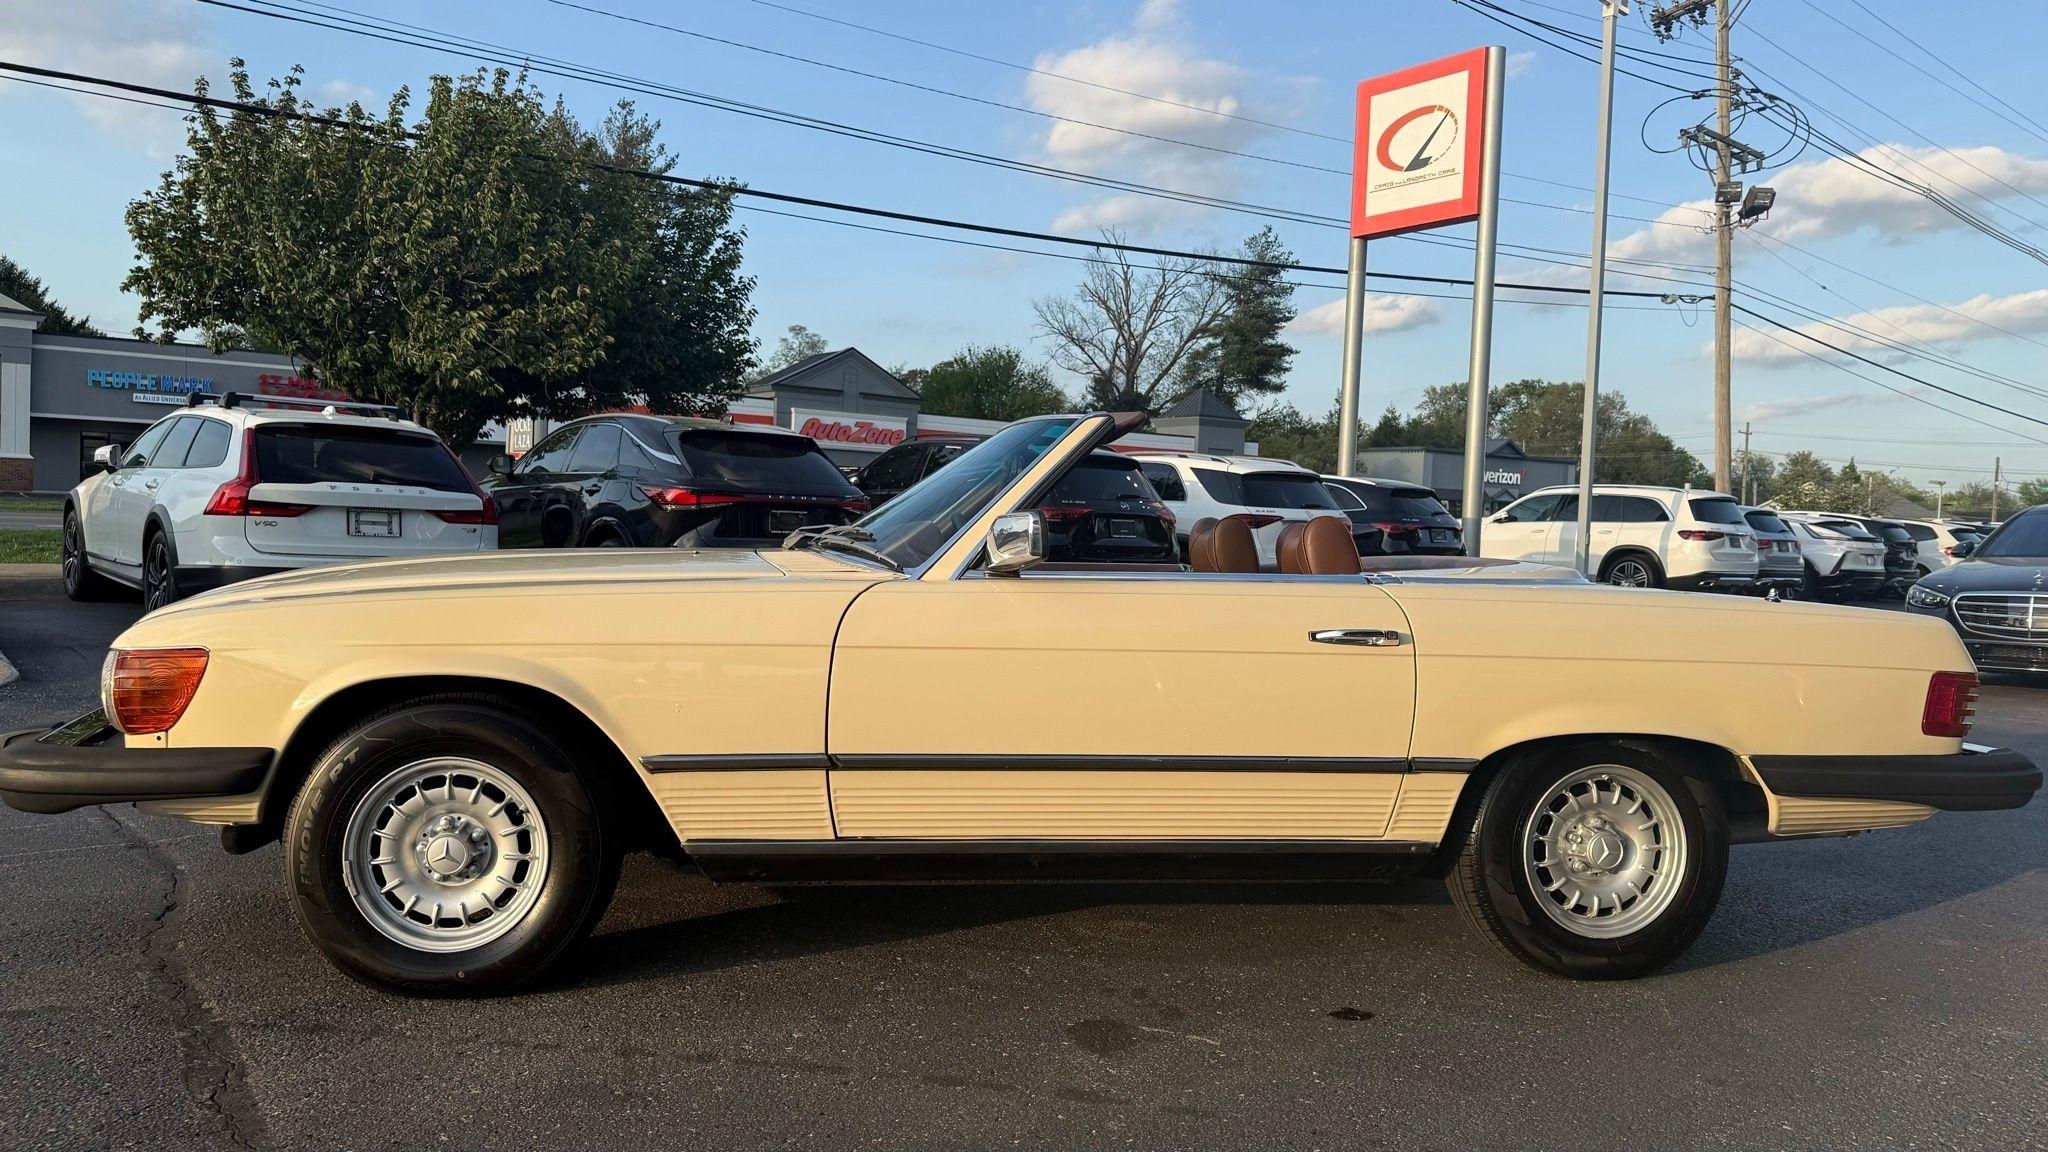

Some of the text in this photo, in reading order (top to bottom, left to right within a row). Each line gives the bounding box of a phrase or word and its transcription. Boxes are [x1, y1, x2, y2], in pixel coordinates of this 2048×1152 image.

[87, 369, 214, 393] PEOPLE MARK
[514, 434, 531, 448] LAZA
[799, 417, 906, 446] AutoZone
[484, 468, 521, 485] verizon
